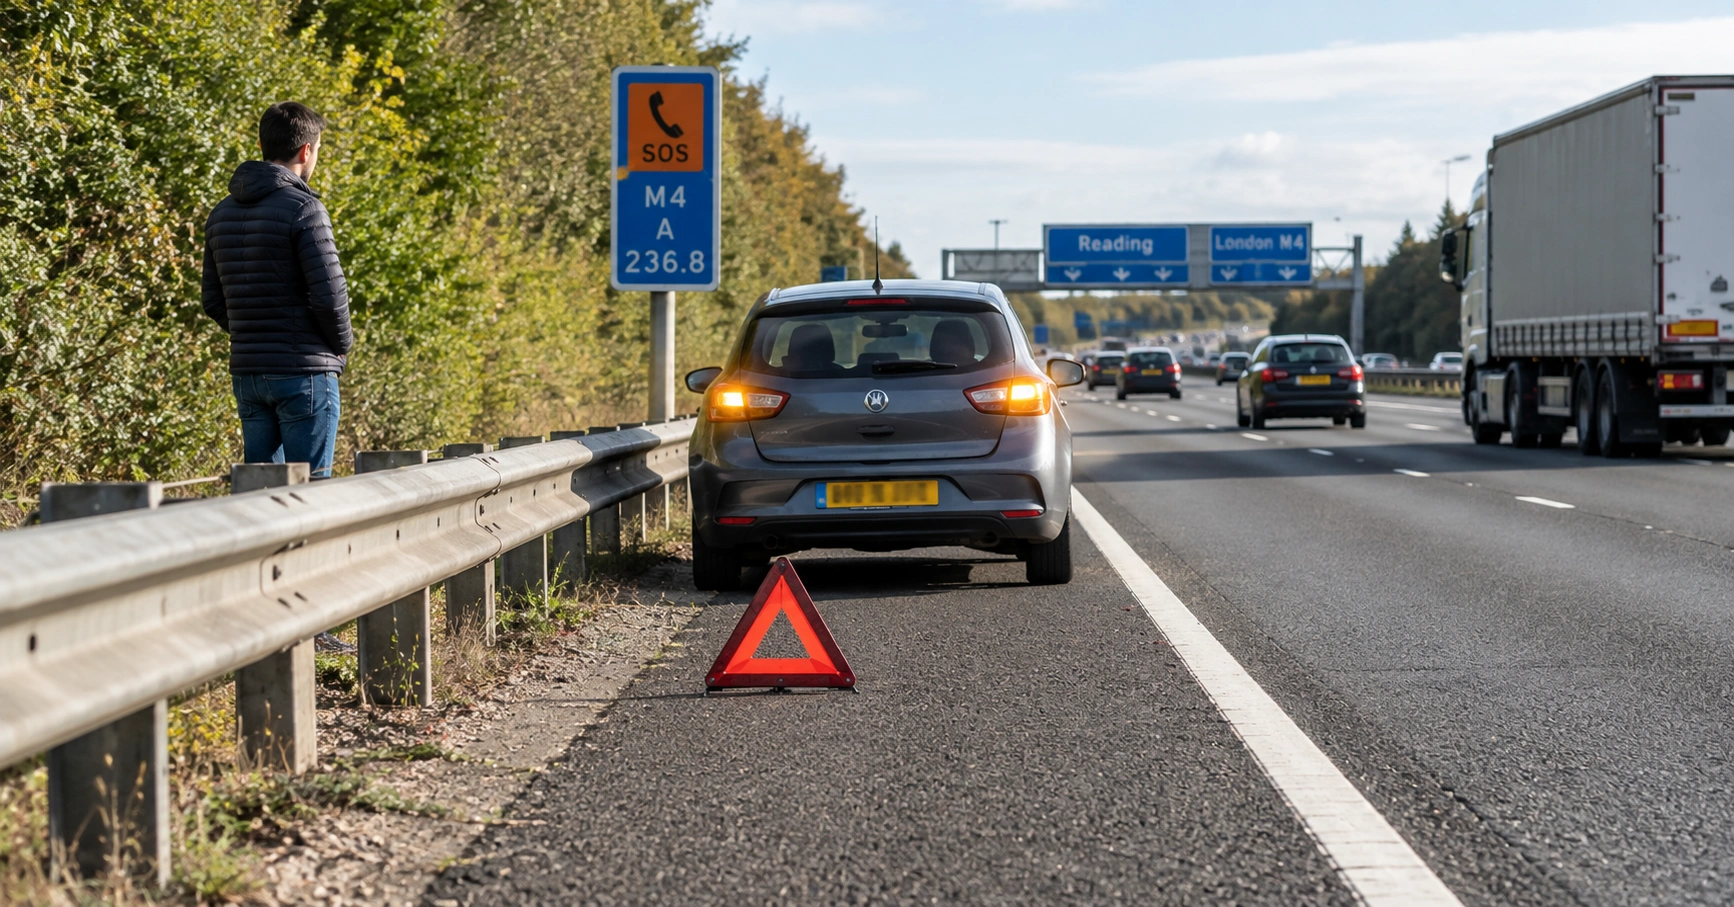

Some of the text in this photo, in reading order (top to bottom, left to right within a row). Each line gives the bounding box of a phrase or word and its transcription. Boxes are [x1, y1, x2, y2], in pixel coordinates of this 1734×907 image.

[642, 143, 689, 163] SOS
[645, 185, 686, 208] M4
[656, 217, 675, 240] A
[1078, 234, 1154, 255] Reading
[1215, 234, 1304, 250] London M4
[625, 250, 705, 273] 236.8
